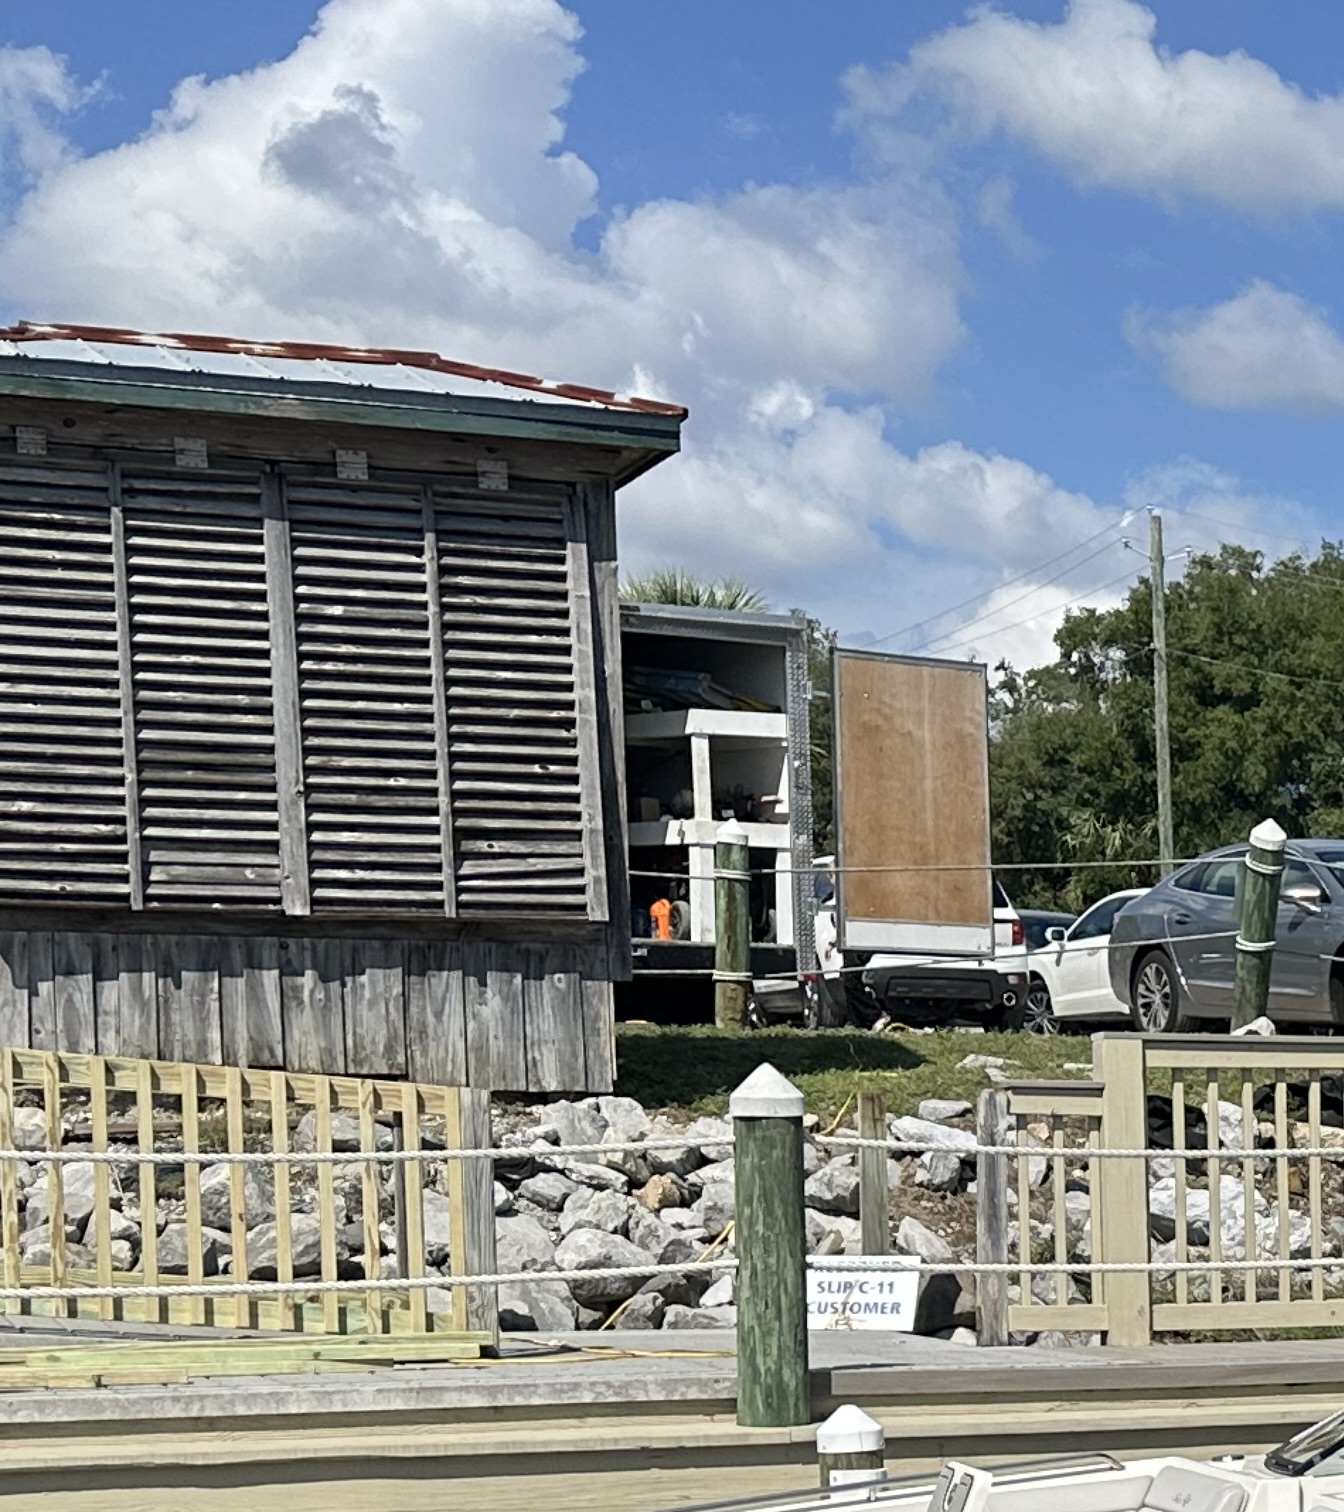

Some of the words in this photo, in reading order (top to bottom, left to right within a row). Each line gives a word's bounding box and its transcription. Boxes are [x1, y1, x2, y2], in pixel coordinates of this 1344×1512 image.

[816, 1281, 853, 1294] SLIP
[858, 1280, 895, 1294] C-11
[806, 1301, 902, 1315] CUSTOMER
